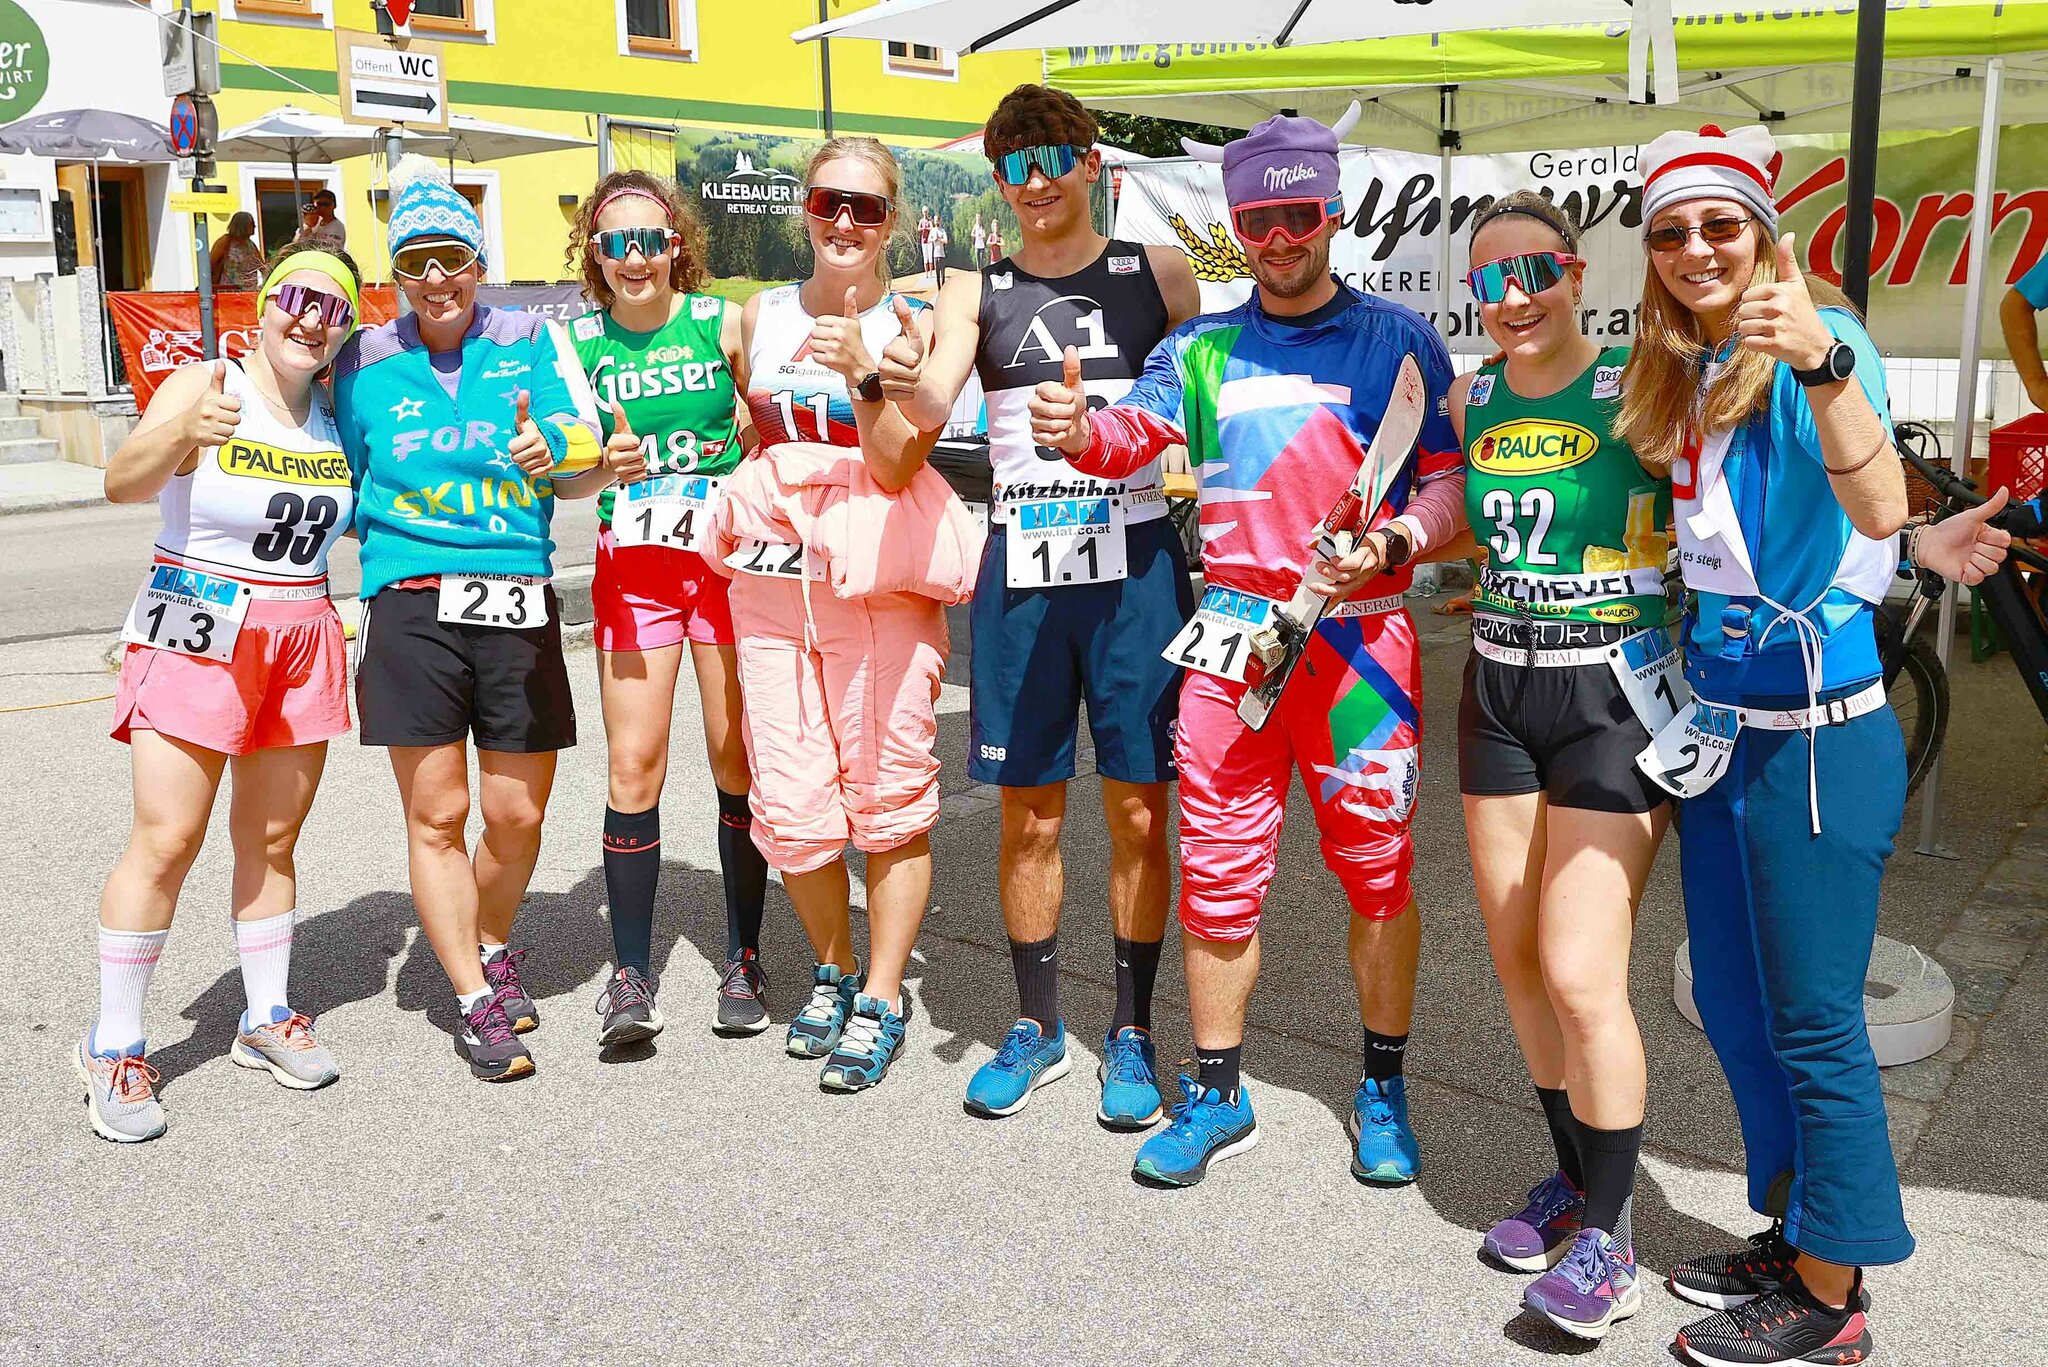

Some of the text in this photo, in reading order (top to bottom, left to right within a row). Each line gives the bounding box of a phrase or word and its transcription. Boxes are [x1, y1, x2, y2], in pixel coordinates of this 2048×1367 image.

[355, 55, 434, 78] Öffentl. WC
[1263, 162, 1318, 192] Milka
[1529, 144, 1638, 179] Gerald
[701, 182, 790, 201] KLEEBAUER
[727, 203, 804, 215] RETREAT CENTER
[1002, 309, 1120, 369] A1
[590, 355, 723, 414] Gösser
[769, 389, 830, 443] 11
[391, 420, 500, 462] FOR
[637, 430, 699, 475] 48
[1495, 434, 1580, 460] RAUCH
[386, 475, 555, 519] SKIING
[1032, 501, 1099, 527] IAT
[251, 491, 339, 566] 33
[635, 507, 695, 547] 1.4
[1022, 524, 1111, 541] www.iat.co.at
[1481, 487, 1558, 565] 32
[1032, 536, 1099, 583] 1.1
[146, 589, 231, 616] www.iat.co.at
[159, 568, 229, 602] IAT
[460, 580, 527, 626] 2.3
[1336, 595, 1401, 615] ENERALI
[146, 602, 216, 654] 1.3
[1603, 607, 1636, 618] RAUCH
[1179, 621, 1243, 674] 2.1
